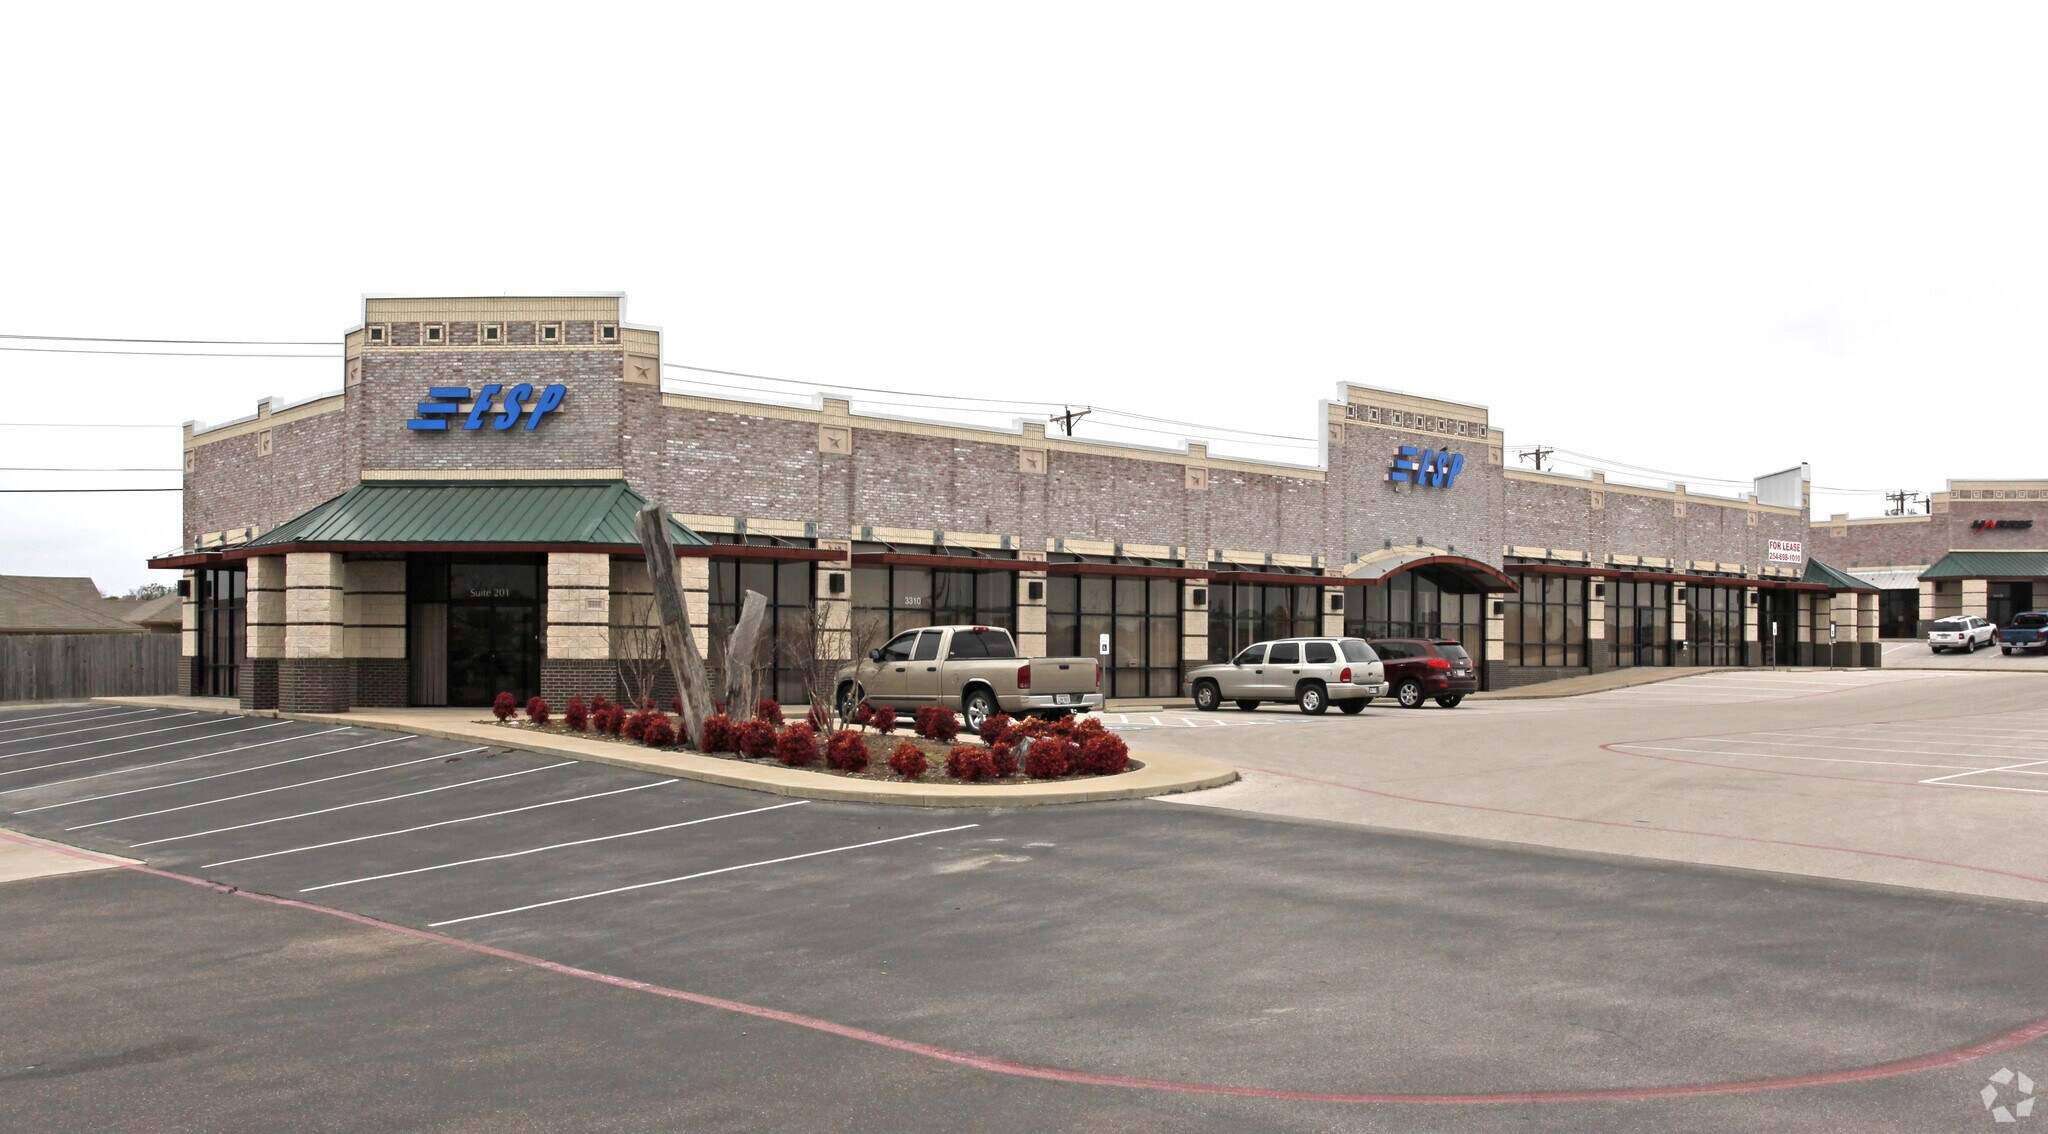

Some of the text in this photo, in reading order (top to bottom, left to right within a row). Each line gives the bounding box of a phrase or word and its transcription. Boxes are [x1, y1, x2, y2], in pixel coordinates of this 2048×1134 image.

[463, 383, 568, 431] ESP
[1415, 449, 1465, 489] ESP
[1769, 541, 1801, 552] FOR LEASE
[470, 588, 510, 597] Suite 201
[904, 596, 921, 605] 3310
